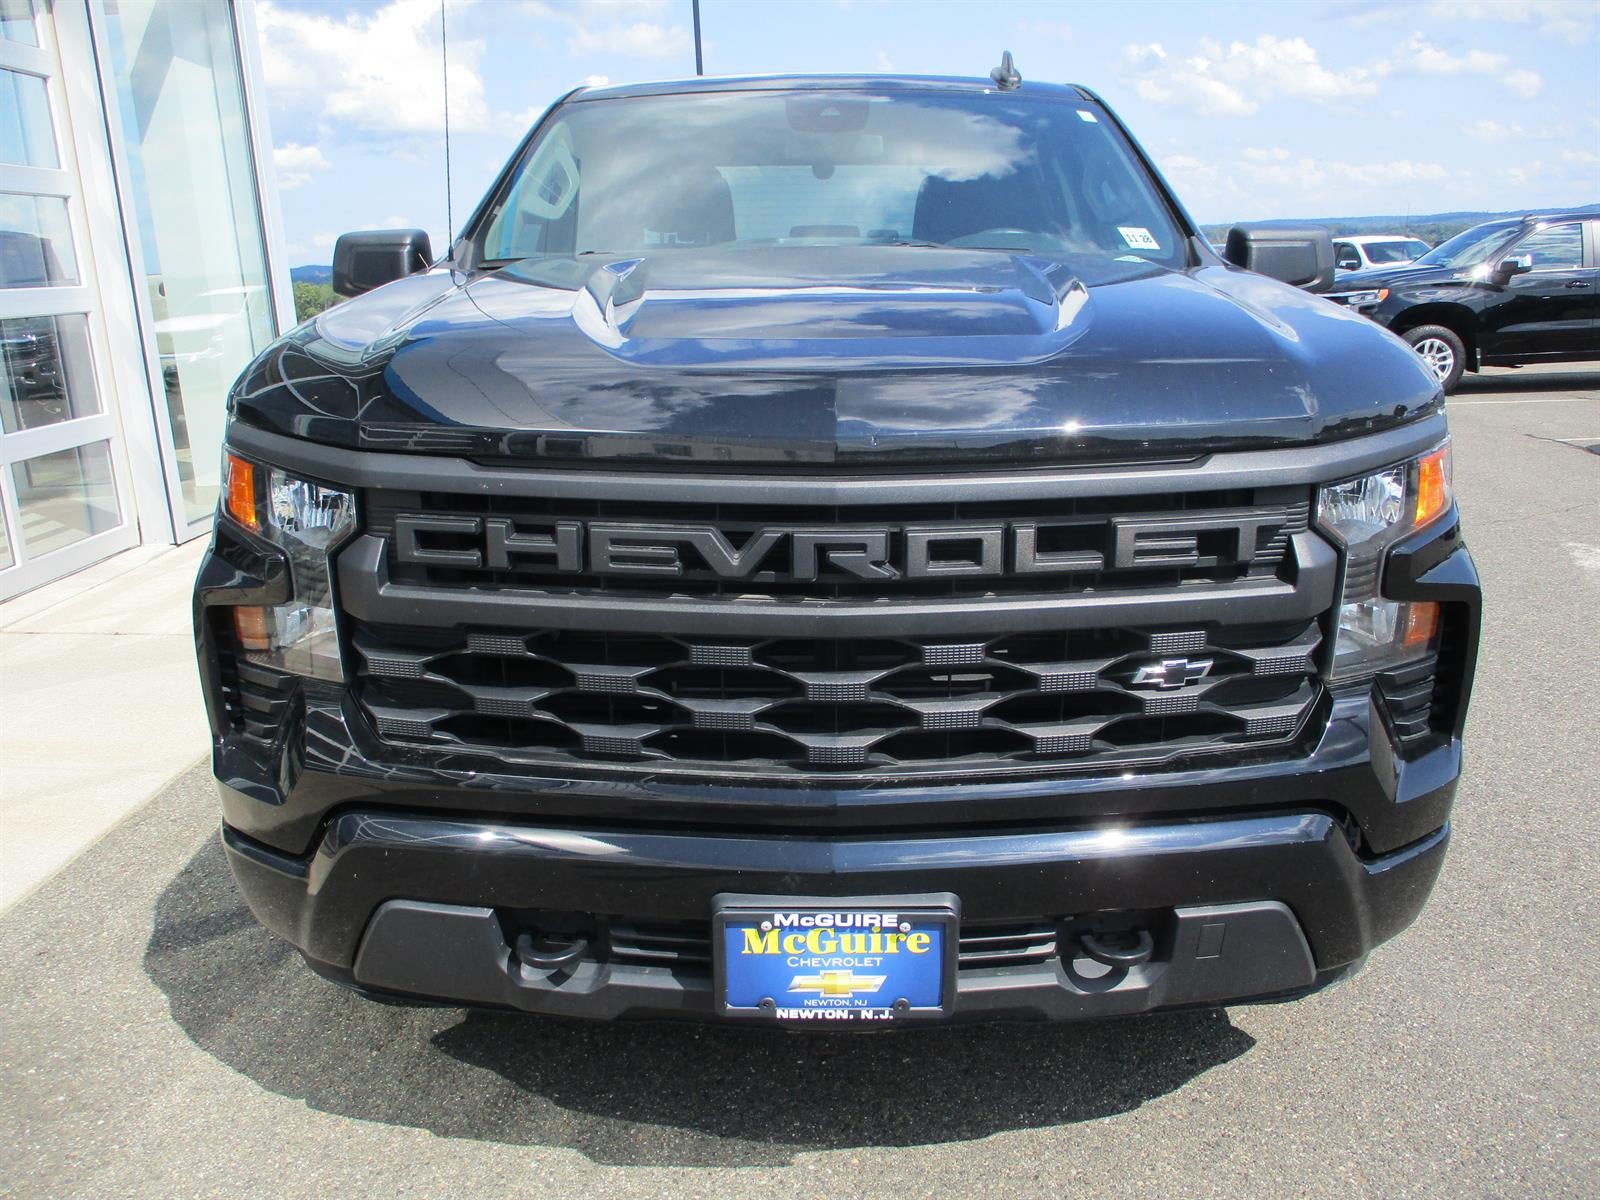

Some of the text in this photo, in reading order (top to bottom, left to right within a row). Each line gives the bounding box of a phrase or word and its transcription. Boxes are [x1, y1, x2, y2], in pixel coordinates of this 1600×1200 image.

[395, 506, 1288, 583] CHEVROLET
[773, 912, 899, 928] McGUIRE
[741, 927, 931, 955] McGuire
[786, 956, 884, 967] CHEVROLET
[804, 999, 868, 1007] NEWTON, NJ
[860, 1009, 895, 1020] N.J.
